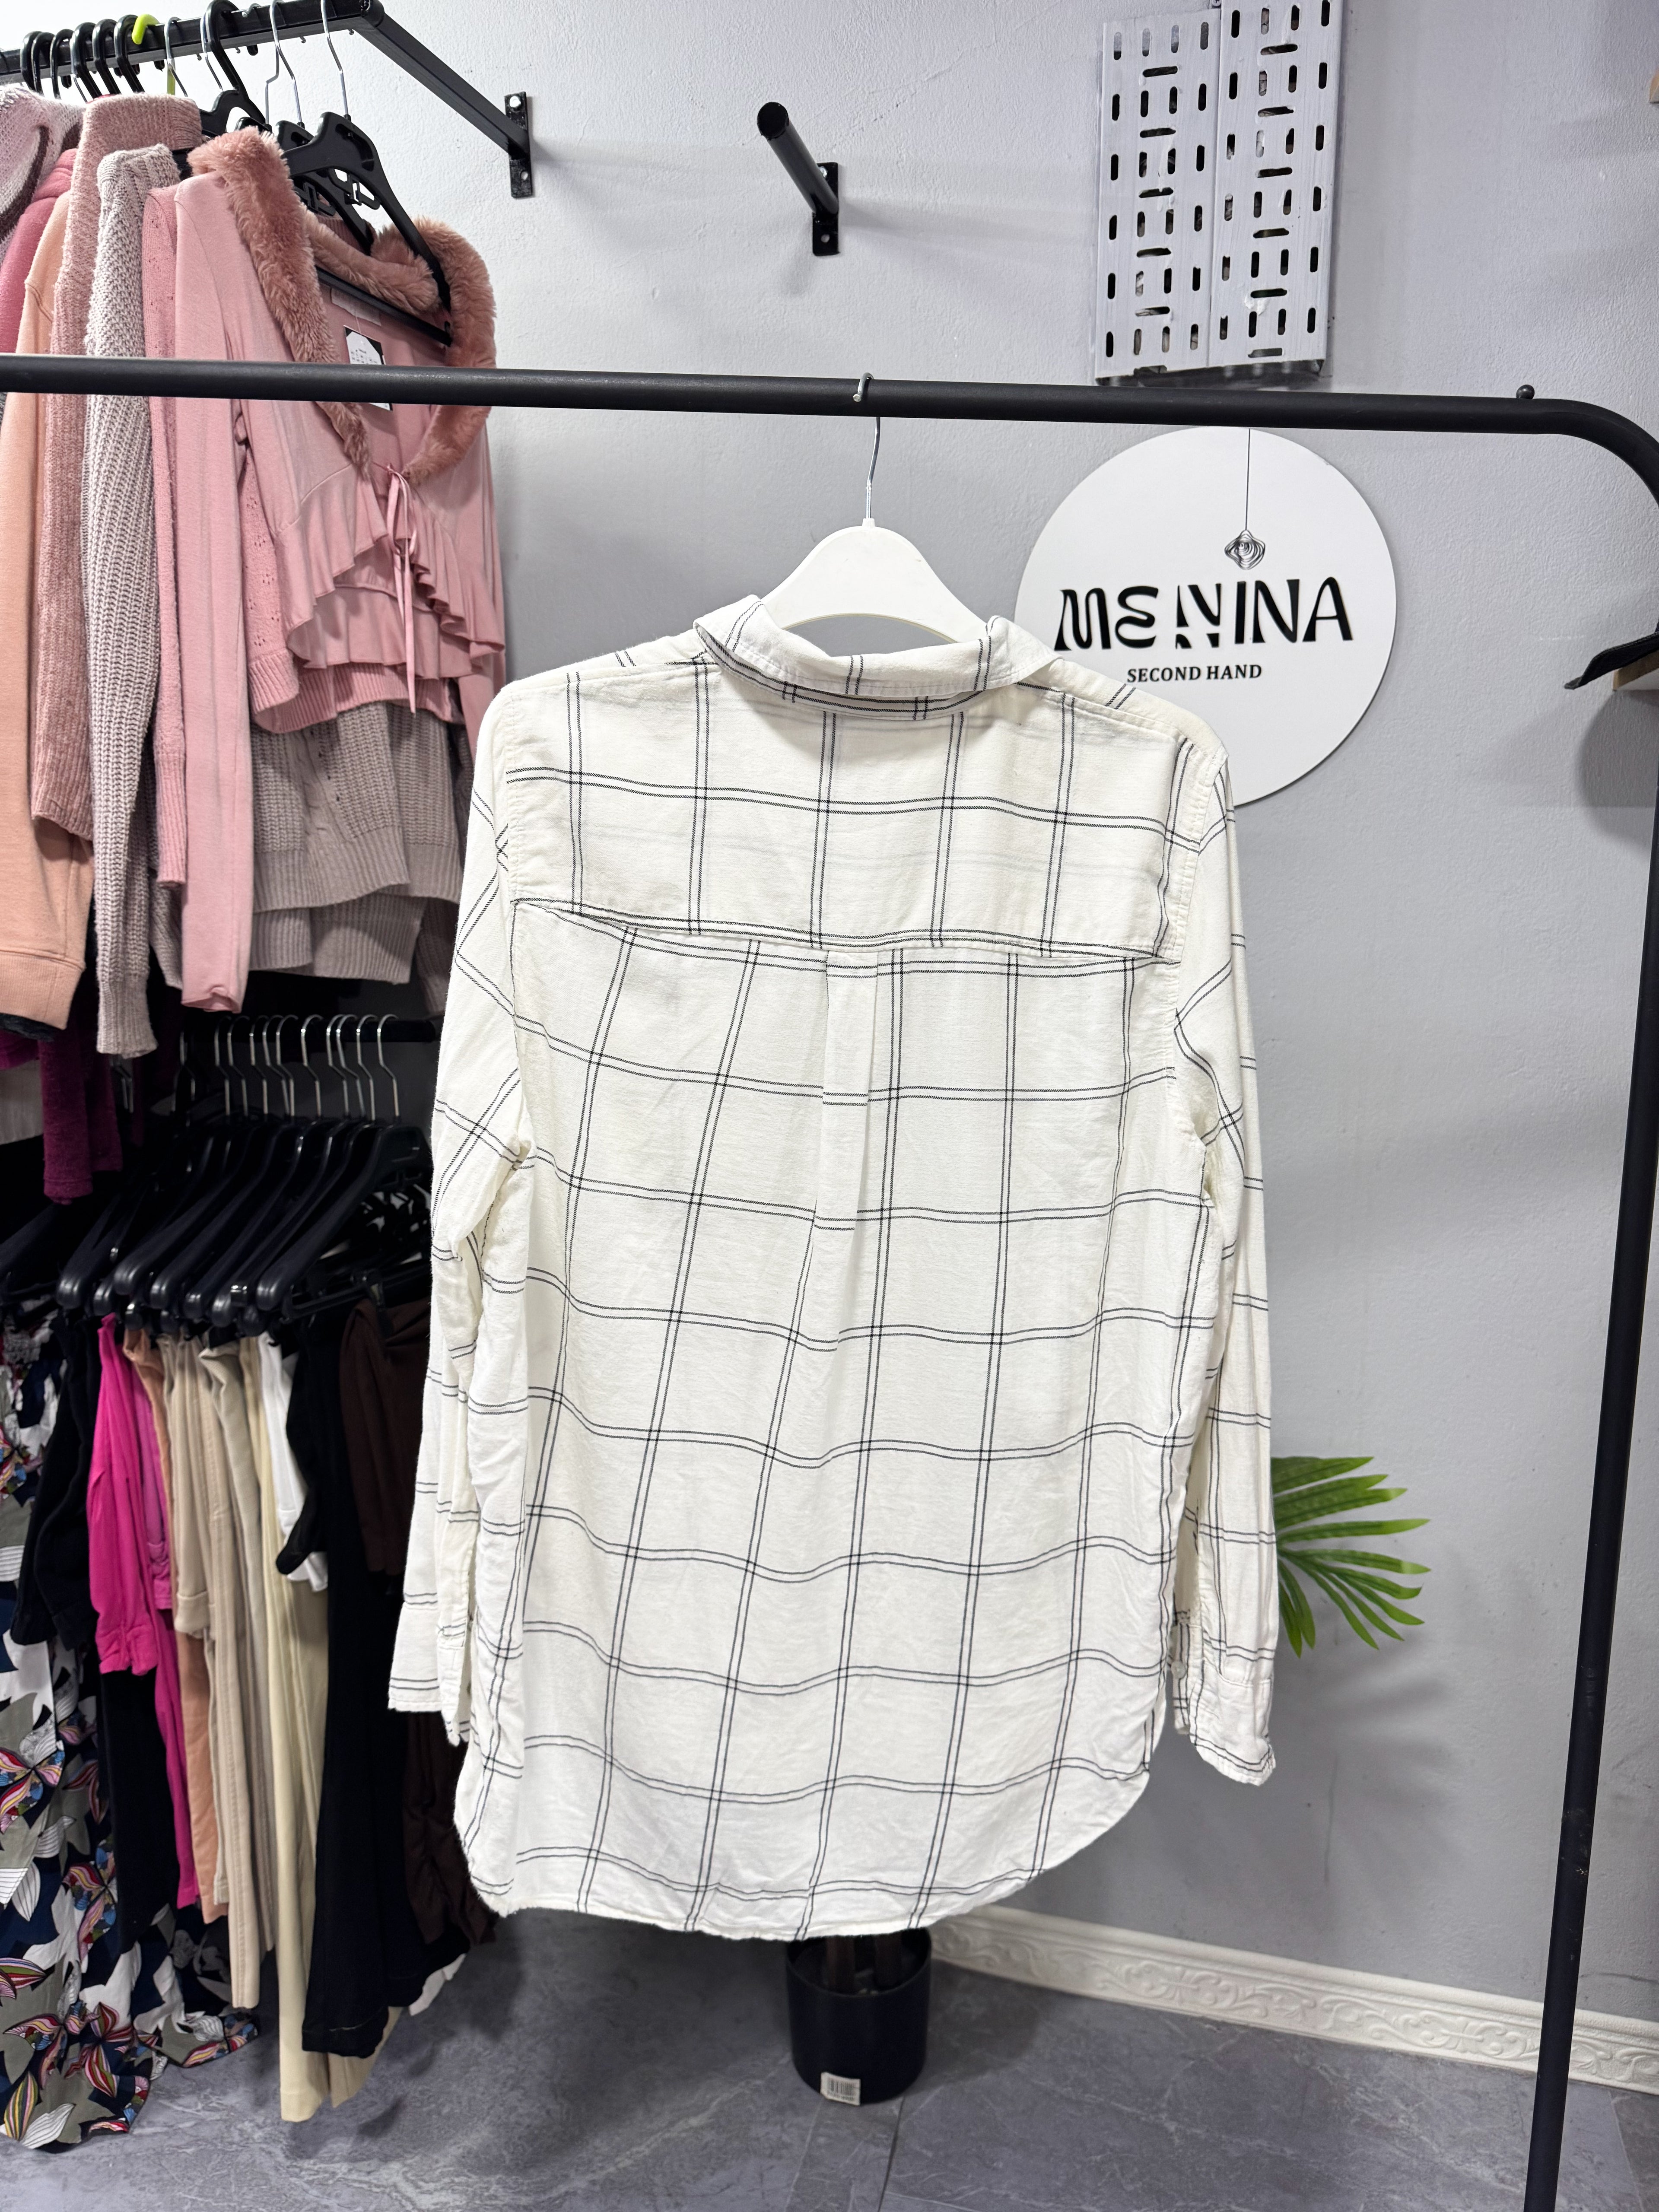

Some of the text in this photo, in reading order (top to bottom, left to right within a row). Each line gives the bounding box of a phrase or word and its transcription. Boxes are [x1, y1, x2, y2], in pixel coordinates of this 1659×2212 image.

[1053, 576, 1353, 652] MENINA
[1127, 664, 1262, 683] SECOND HAND
